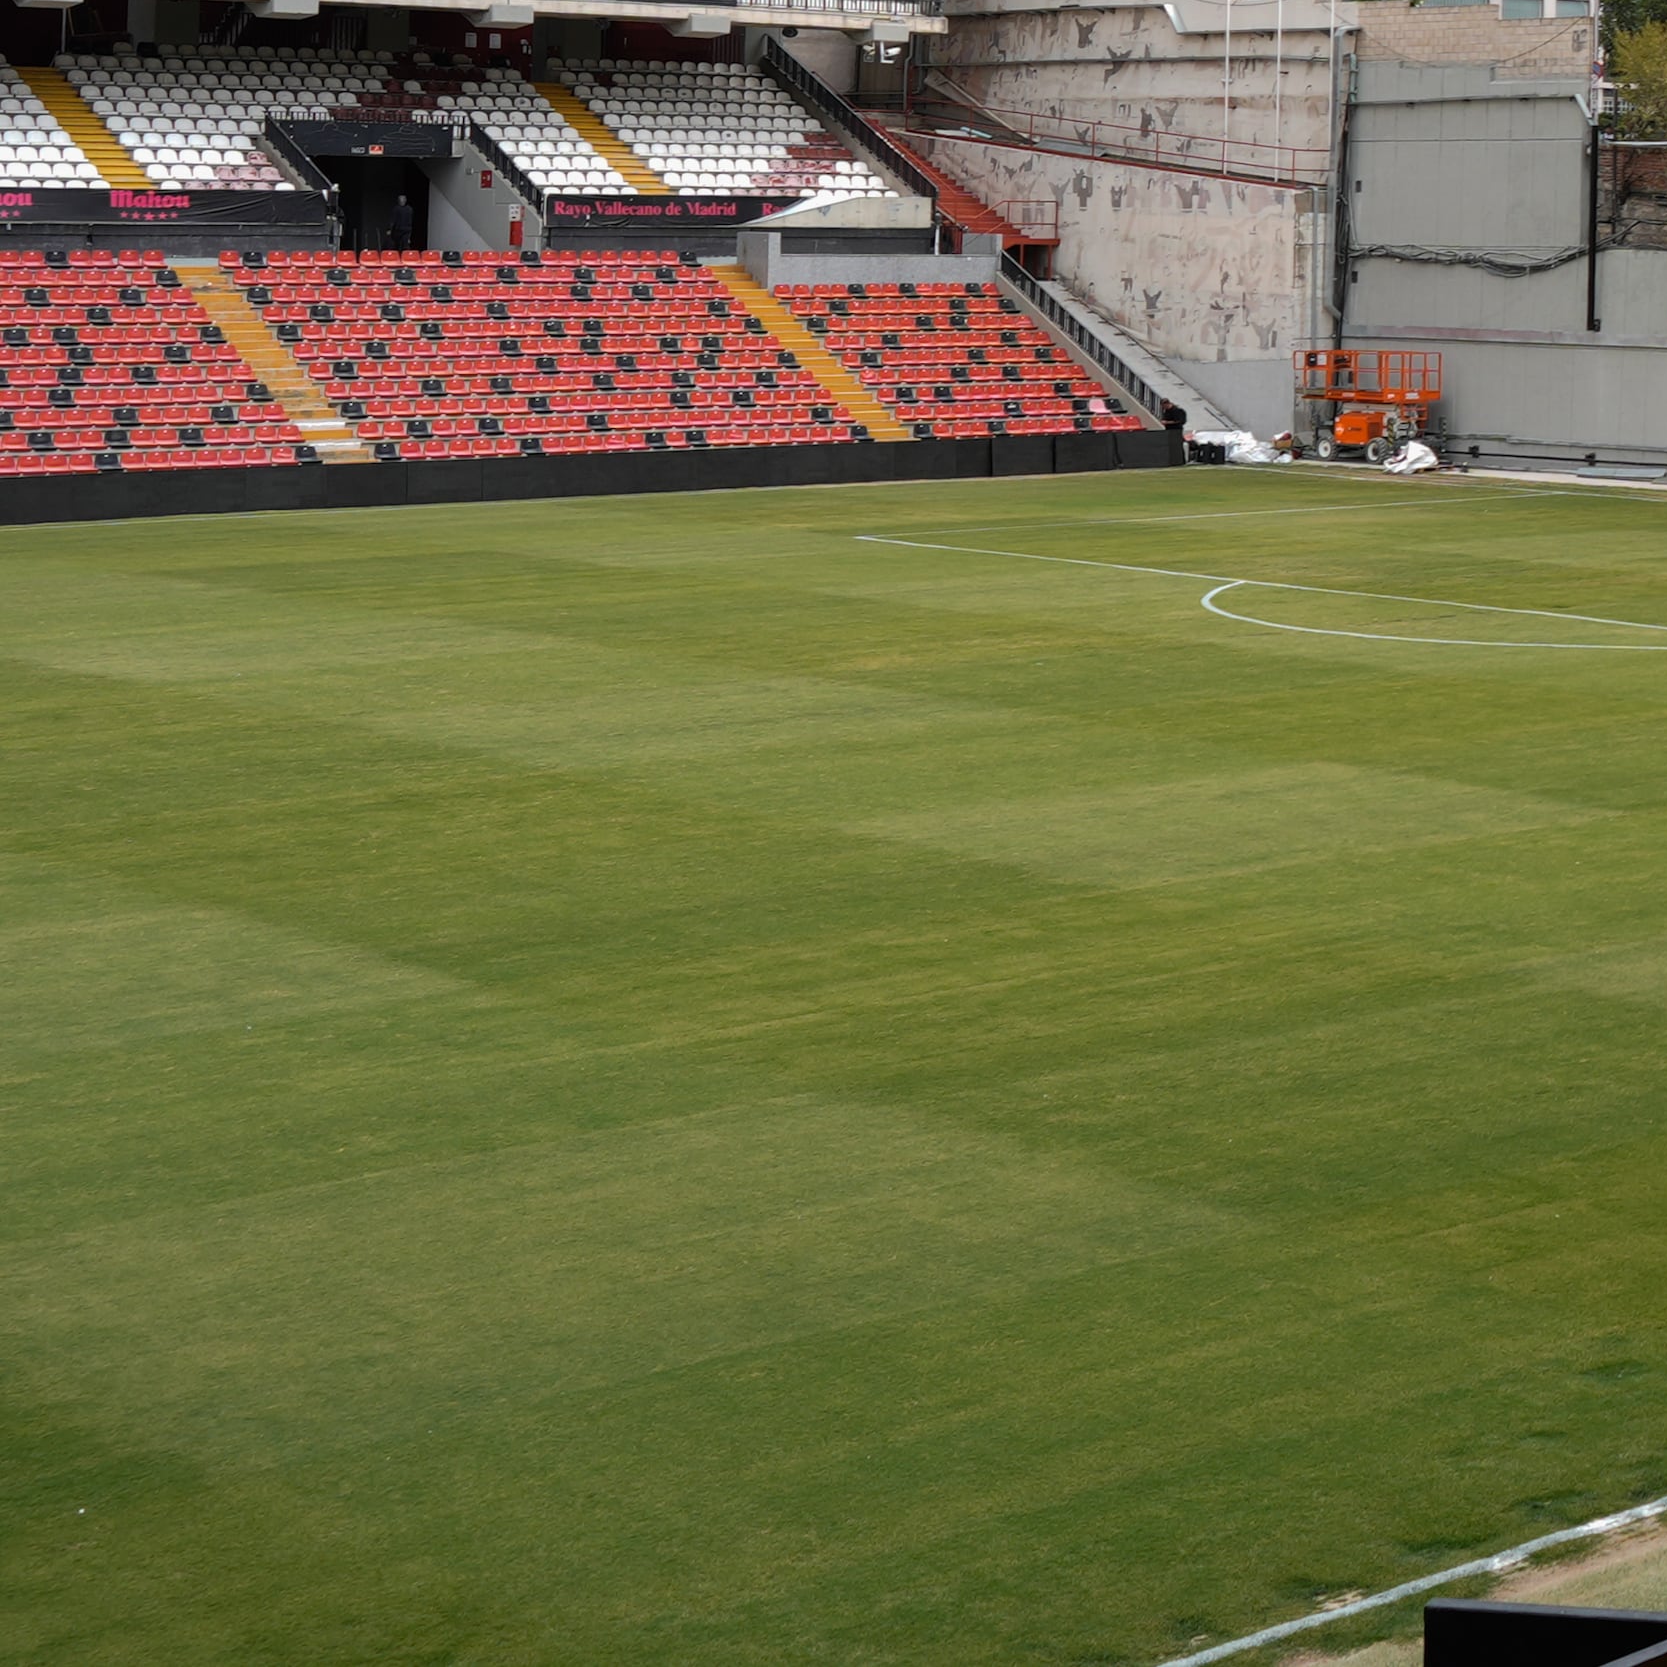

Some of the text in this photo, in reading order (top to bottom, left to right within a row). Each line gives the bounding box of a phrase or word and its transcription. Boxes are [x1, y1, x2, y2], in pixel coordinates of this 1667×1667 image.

[0, 191, 33, 206] ou
[110, 189, 191, 208] Mahou
[554, 200, 737, 218] Rayo Vallecano de Madrid
